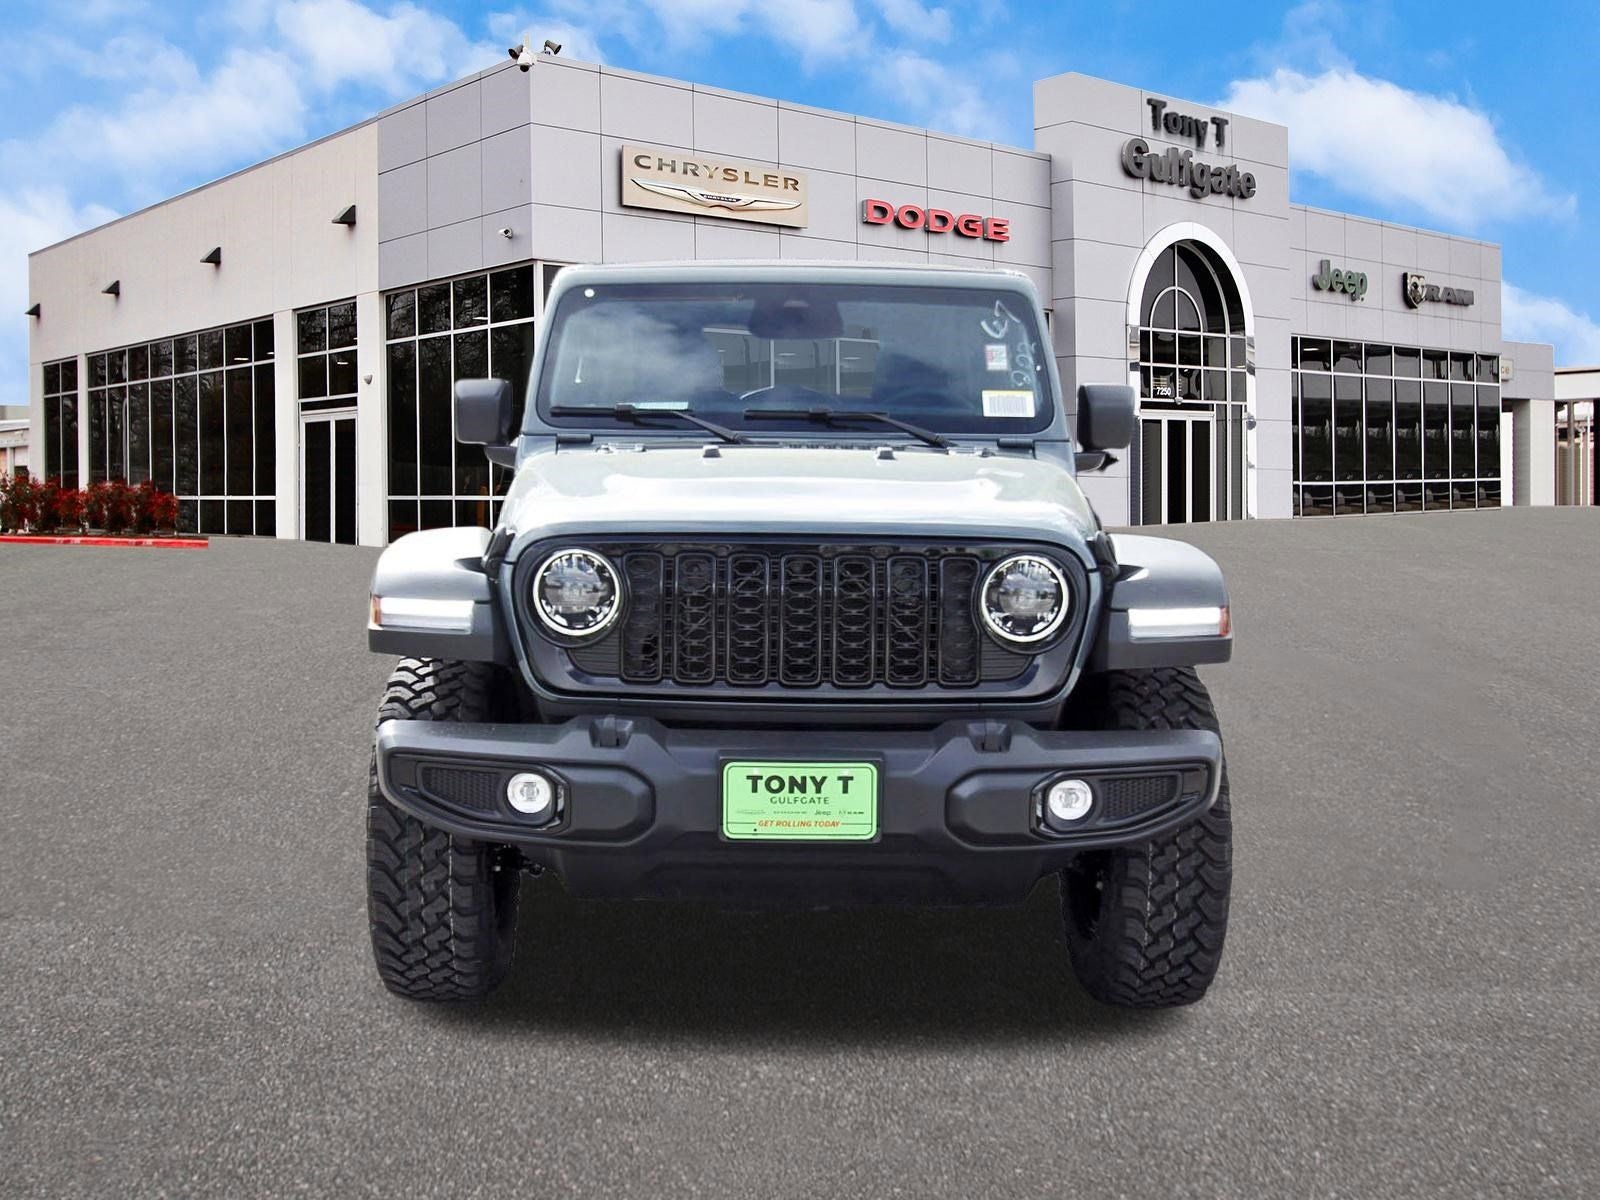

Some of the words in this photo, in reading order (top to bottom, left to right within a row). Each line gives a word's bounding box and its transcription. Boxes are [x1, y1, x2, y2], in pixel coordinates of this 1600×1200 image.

[1146, 98, 1208, 147] Tony
[1210, 116, 1229, 147] T
[634, 154, 799, 192] CHRYSLER
[1121, 138, 1256, 199] Gulfgate
[862, 199, 1010, 242] DODGE
[1313, 259, 1368, 301] Jeep
[1425, 284, 1474, 306] RAM
[1156, 386, 1171, 396] 7250
[746, 775, 828, 794] TONY
[837, 775, 854, 794] T
[770, 796, 830, 805] GULFGATE
[776, 820, 812, 828] ROLLING
[814, 820, 840, 828] TODAY
